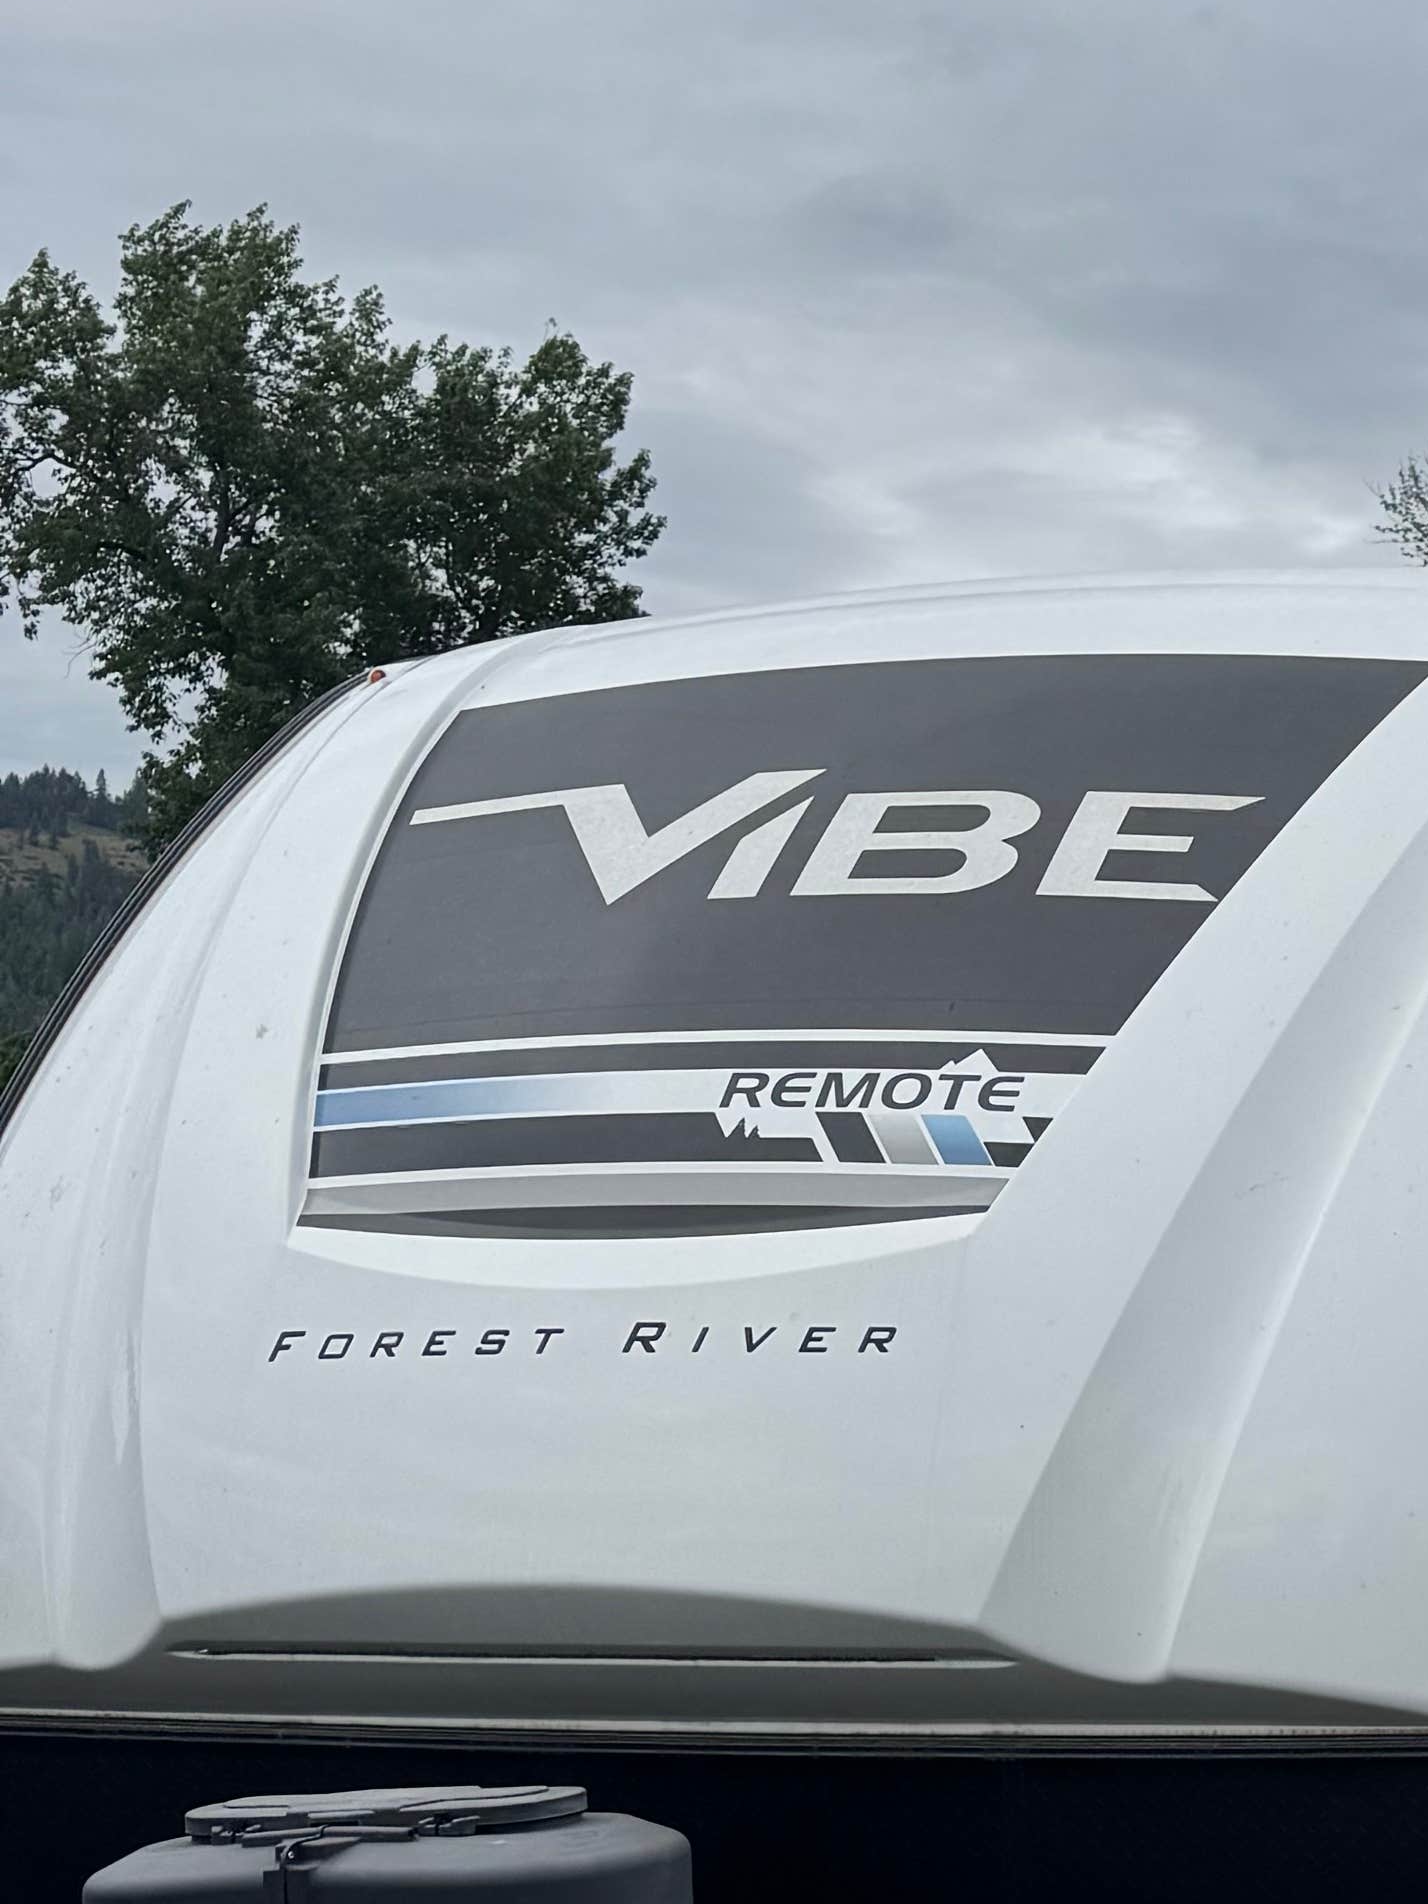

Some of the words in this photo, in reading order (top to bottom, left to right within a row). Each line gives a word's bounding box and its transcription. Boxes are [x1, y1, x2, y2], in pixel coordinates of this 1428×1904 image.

[409, 768, 1266, 906] VIBE
[718, 1072, 1025, 1113] REMOTE
[268, 1329, 565, 1363] FOREST
[621, 1321, 897, 1354] RIVER
